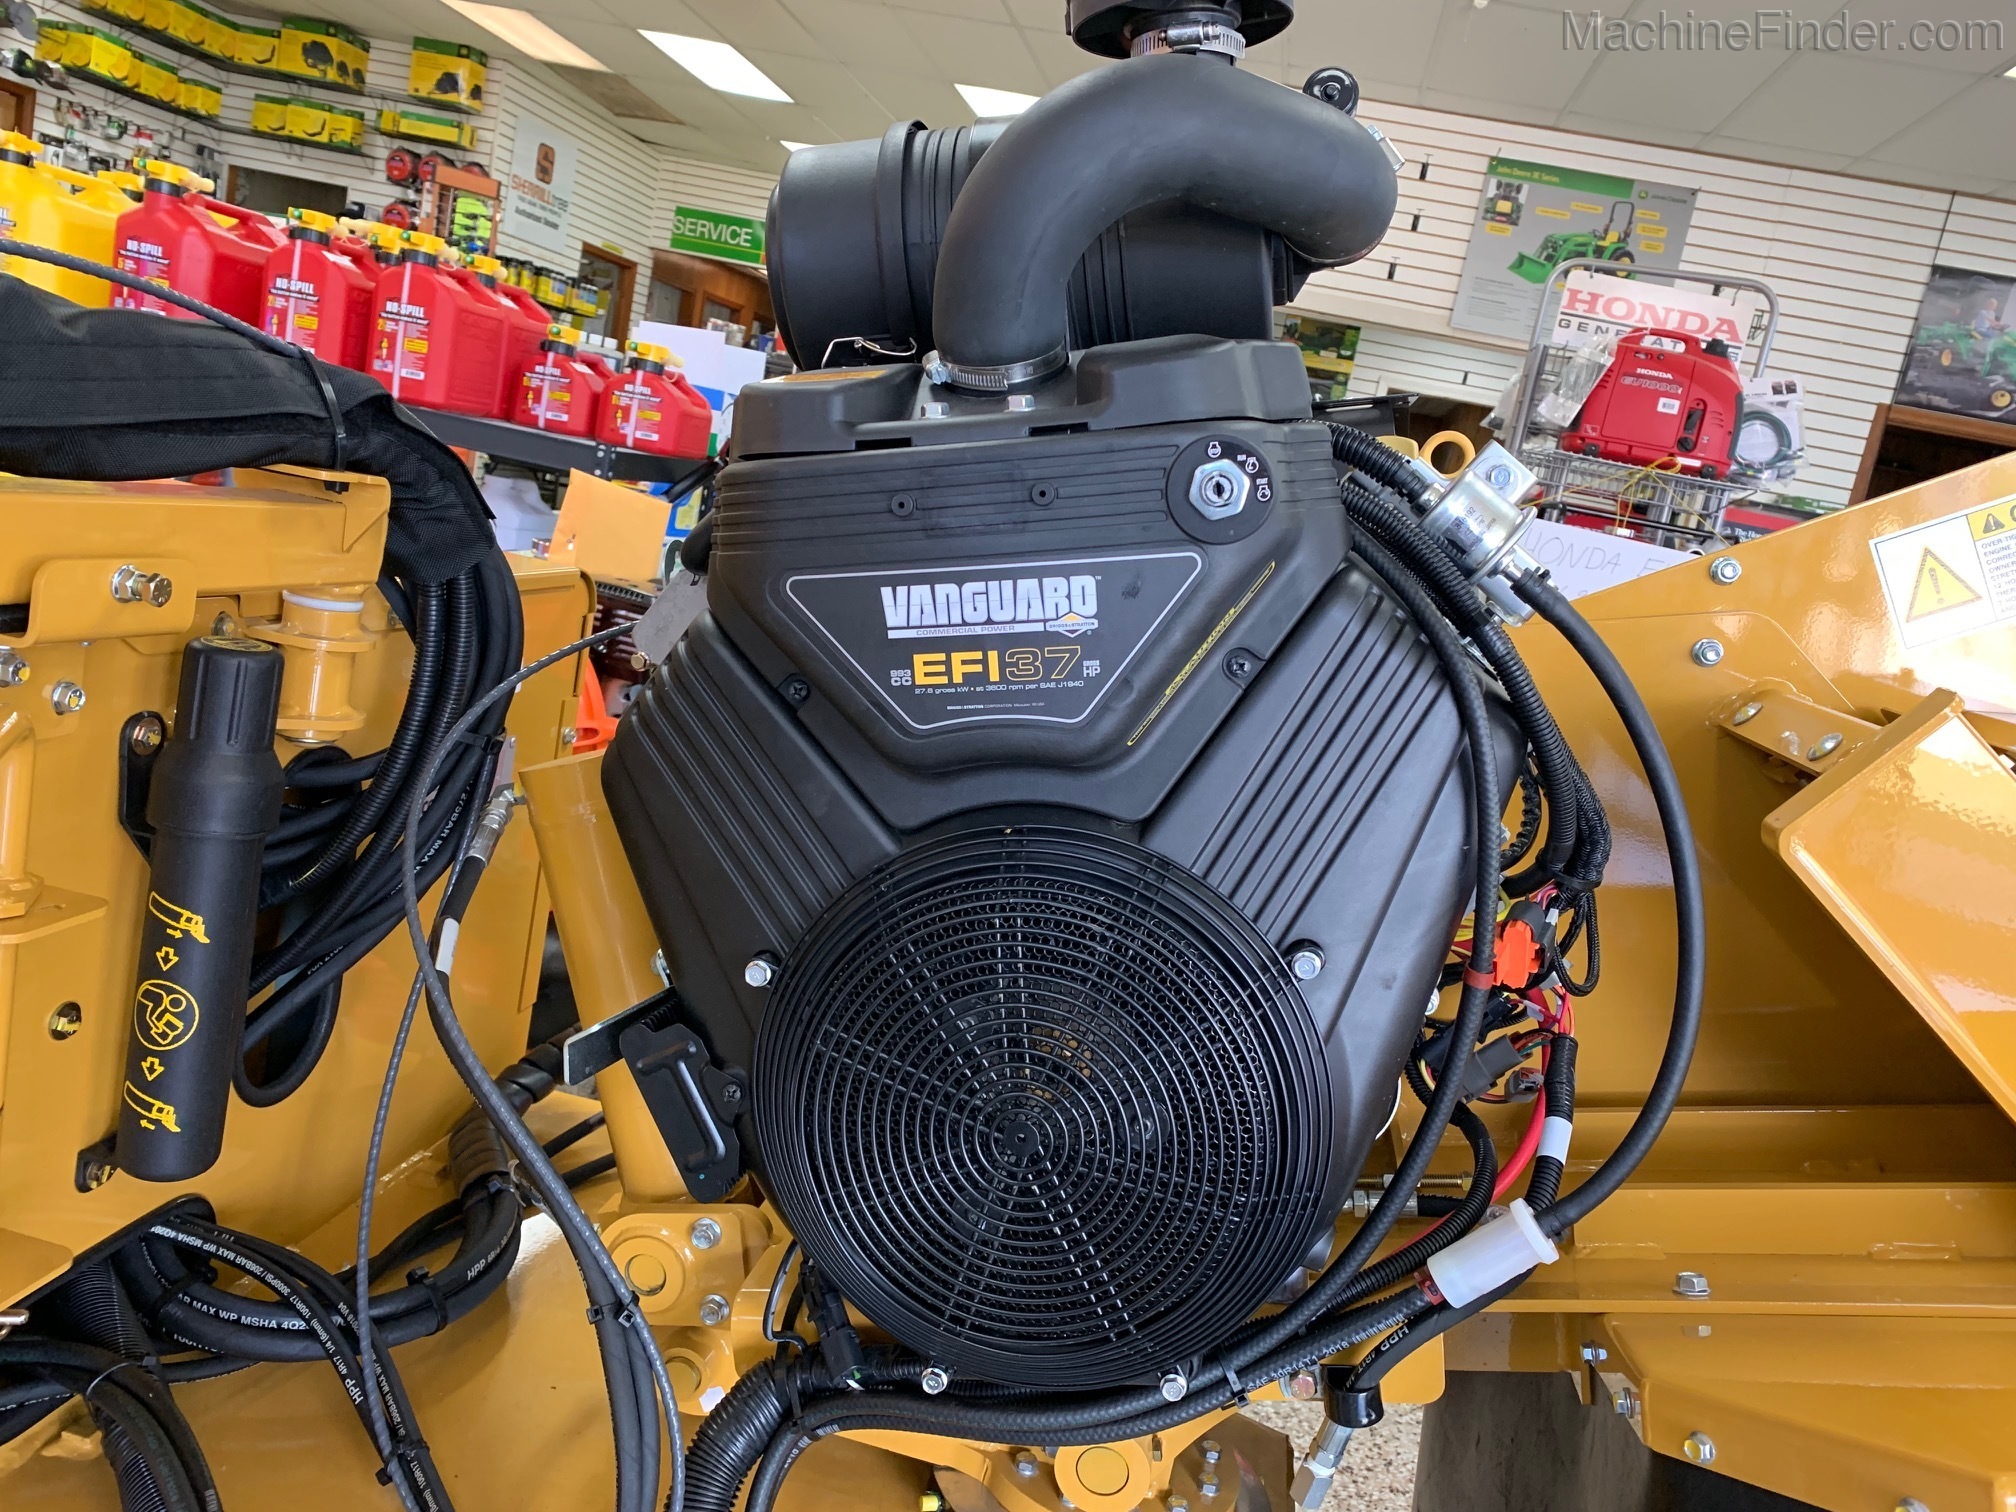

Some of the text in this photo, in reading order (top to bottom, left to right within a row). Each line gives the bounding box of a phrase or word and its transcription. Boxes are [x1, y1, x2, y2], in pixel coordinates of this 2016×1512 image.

[672, 216, 753, 247] SERVICE
[276, 277, 314, 294] NO-SPILL
[386, 301, 425, 318] NO-SPILL
[1562, 287, 1743, 343] HONDA
[1636, 367, 1673, 380] HONDA
[1523, 528, 1621, 574] HONDA
[1984, 544, 2012, 557] ENGINE
[880, 575, 1098, 628] VANGUARD
[916, 625, 1015, 636] COMMERCIAL POWER
[890, 670, 911, 678] 993
[1083, 666, 1100, 678] HP
[890, 677, 912, 686] CC
[935, 687, 956, 695] gross
[178, 1233, 203, 1248] MSHA
[202, 1242, 217, 1252] WP
[217, 1247, 236, 1262] MAX
[235, 1256, 264, 1276] 206BAR
[467, 1259, 486, 1280] HPP
[265, 1274, 291, 1296] 3000PSI
[193, 1301, 216, 1315] MAX
[219, 1310, 238, 1321] WP
[240, 1316, 278, 1329] MSHA
[289, 1295, 311, 1319] 100R17
[1380, 1325, 1410, 1351] HPP
[1247, 1377, 1269, 1393] SAE
[1322, 1341, 1350, 1357] 2018
[345, 1378, 364, 1405] HPP
